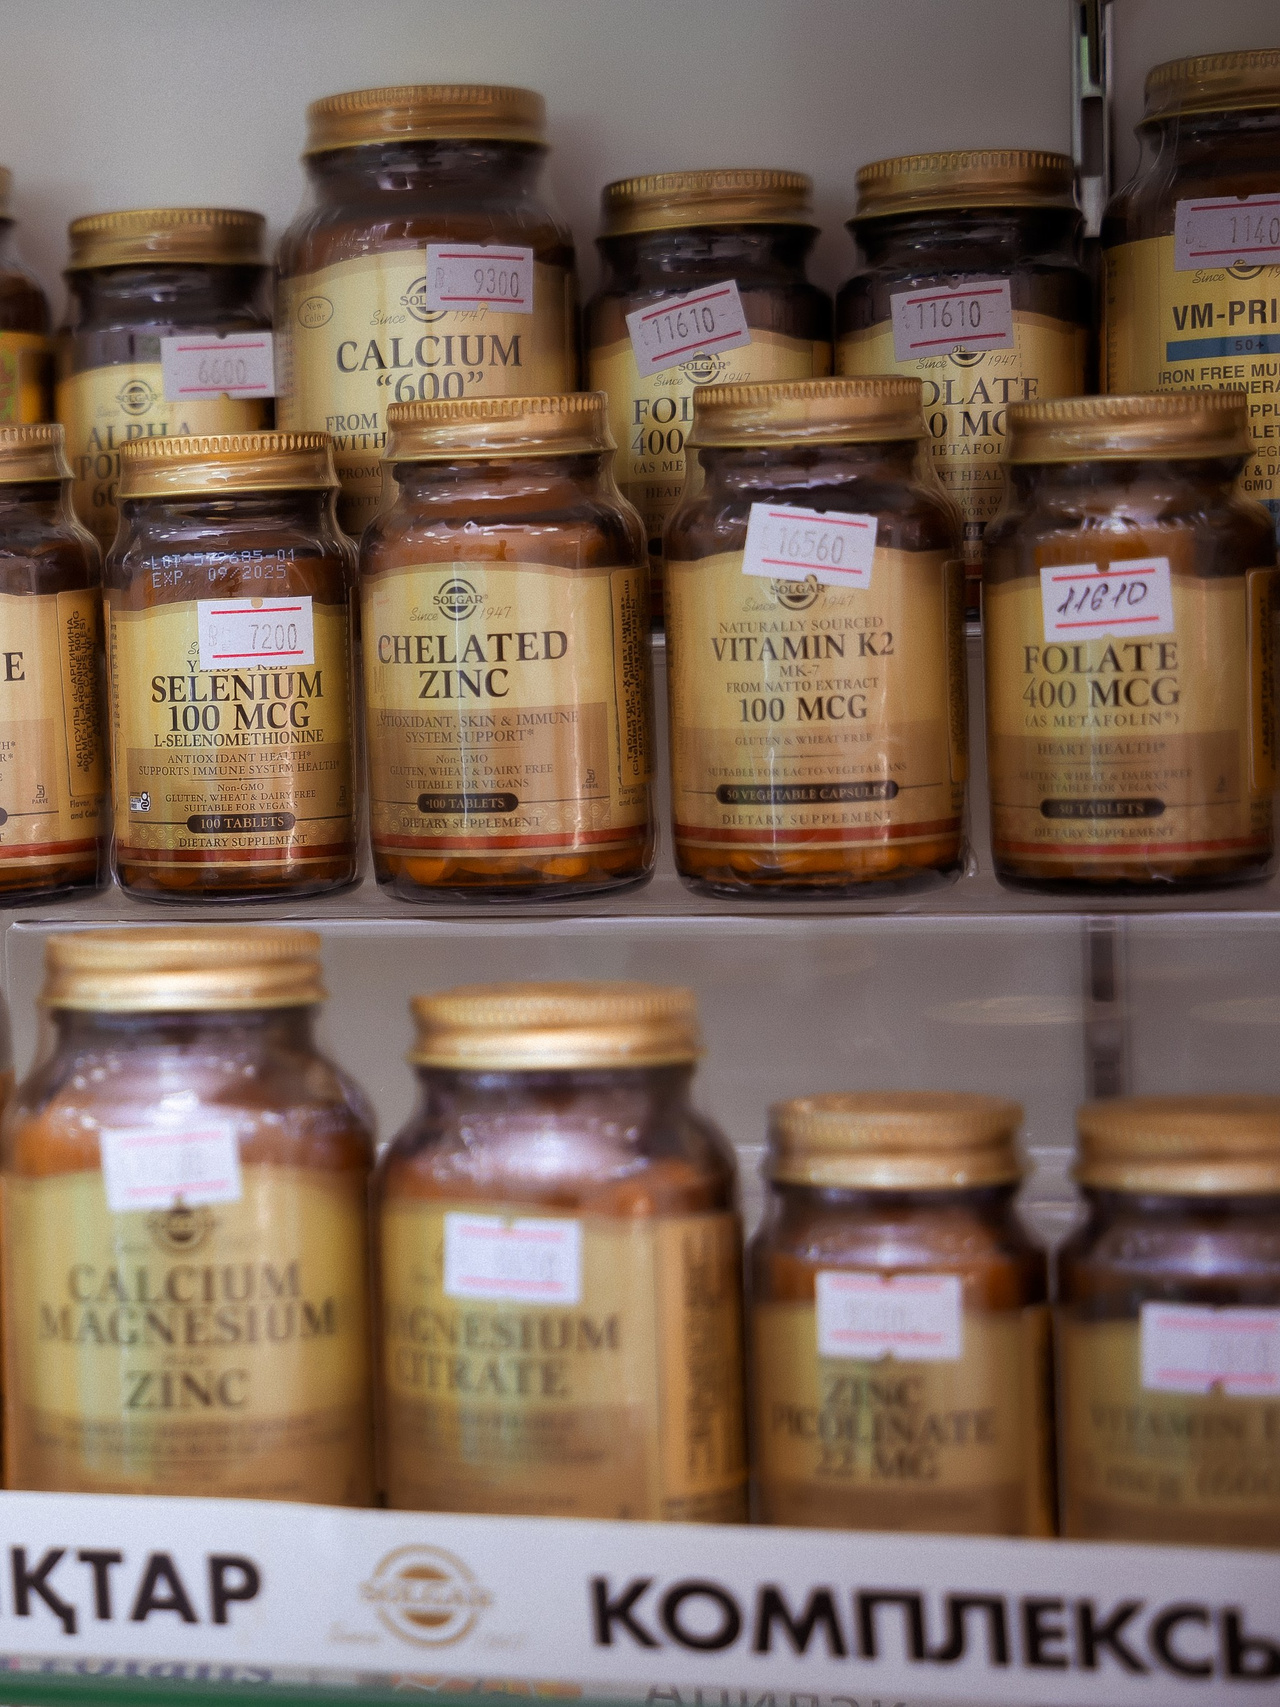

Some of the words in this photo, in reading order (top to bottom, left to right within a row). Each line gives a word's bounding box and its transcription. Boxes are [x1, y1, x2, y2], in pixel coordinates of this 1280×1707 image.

[1231, 215, 1280, 244] 1140
[474, 269, 518, 298] 9300
[1192, 271, 1225, 283] Since
[370, 310, 406, 326] Since
[1172, 299, 1277, 330] VM-PRI
[1235, 339, 1264, 351] 50+
[337, 335, 522, 373] CALCIUM
[916, 358, 947, 369] Since
[988, 354, 1017, 366] 1947
[678, 361, 726, 371] SOLGAR
[654, 375, 683, 386] Since
[1158, 369, 1194, 385] IRON
[1200, 365, 1244, 380] FREE
[632, 397, 694, 425] FOL
[325, 414, 377, 432] FROM
[631, 428, 684, 456] 400
[634, 462, 657, 473] (AS
[207, 565, 287, 581] 09/2025
[433, 594, 483, 605] SOLGAR
[410, 608, 438, 622] Since
[479, 607, 511, 620] 1947
[719, 620, 808, 634] NATURALLY
[812, 616, 883, 631] SOURCED
[249, 624, 298, 650] 7200
[378, 630, 568, 664] CHELATED
[712, 635, 845, 662] VITAMIN
[859, 632, 894, 657] K2
[1023, 642, 1179, 674] FOLATE
[780, 665, 820, 677] MK-7
[152, 671, 323, 703] SELENIUM
[419, 669, 510, 698] ZINC
[726, 681, 762, 693] FROM
[766, 679, 811, 693] NATTO
[816, 677, 879, 691] EXTRACT
[1022, 677, 1076, 709] 400
[1089, 677, 1180, 708] MCG
[169, 705, 220, 732] 100
[233, 702, 310, 730] MCG
[739, 699, 785, 723] 100
[797, 695, 868, 721] MCG
[460, 714, 496, 727] SKIN
[501, 714, 511, 726] &
[516, 711, 578, 726] IMMUNE
[155, 729, 323, 747] L-SELENOMETHIONINE
[406, 731, 452, 743] SYSTEM
[168, 753, 255, 764] ANTIOXIDANT
[436, 754, 488, 764] Non-GMO
[139, 765, 189, 776] SUPPORTS
[193, 765, 245, 775] IMMUNE
[248, 763, 293, 774] SYSTEM
[430, 766, 470, 776] WHEAT
[484, 765, 521, 775] DAIRY
[525, 764, 553, 773] FREE
[217, 782, 264, 792] Non-GMO
[406, 780, 452, 790] SUITABLE
[456, 779, 478, 789] FOR
[482, 778, 529, 788] VEGANS
[210, 792, 247, 801] WHEAT
[251, 792, 257, 800] &
[260, 791, 291, 801] DAIRY
[294, 790, 316, 799] FREE
[450, 797, 505, 809] TABLETS
[184, 803, 232, 812] SUITABLE
[236, 802, 256, 811] FOR
[259, 801, 298, 811] VEGANS
[201, 818, 220, 829] 100
[224, 817, 285, 828] TABLETS
[403, 817, 450, 829] DIETARY
[453, 816, 542, 828] SUPPLEMENT
[179, 837, 229, 848] DIETARY
[232, 834, 308, 847] SUPPLEMENT
[68, 1262, 301, 1303] CALCIUM
[38, 1297, 336, 1345] MAGNESIUM
[125, 1370, 249, 1411] ZINC
